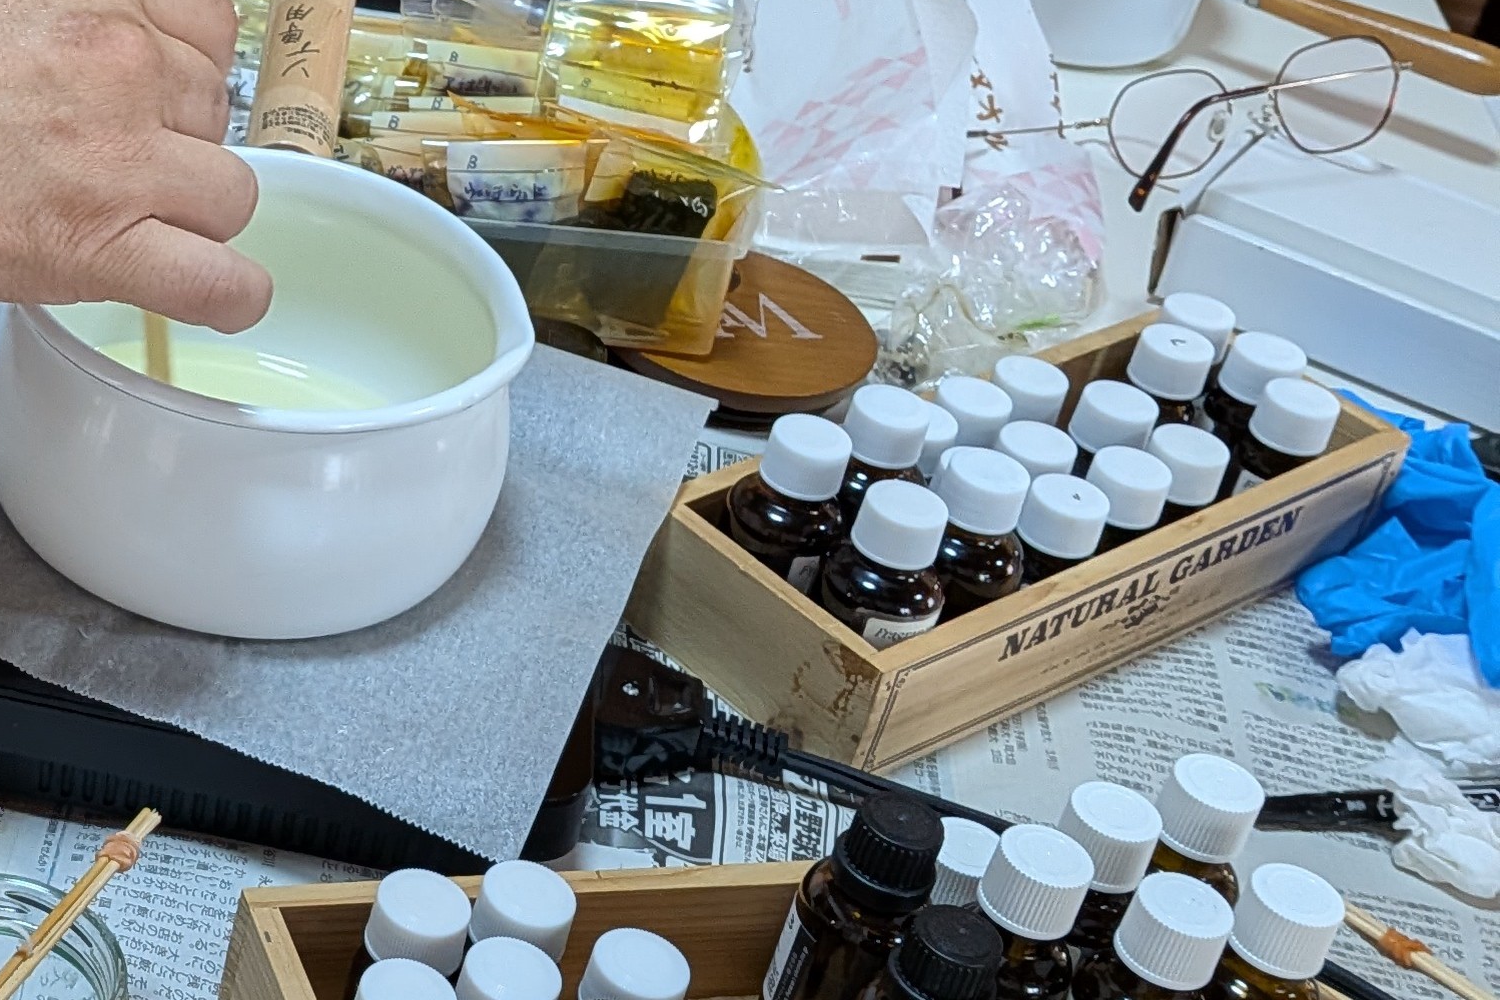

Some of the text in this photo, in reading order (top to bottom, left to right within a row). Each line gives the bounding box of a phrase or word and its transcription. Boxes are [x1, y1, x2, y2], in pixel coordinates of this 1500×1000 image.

[998, 569, 1160, 661] NATURAL
[1170, 506, 1304, 583] GARDEN
[644, 793, 706, 850] 1室
